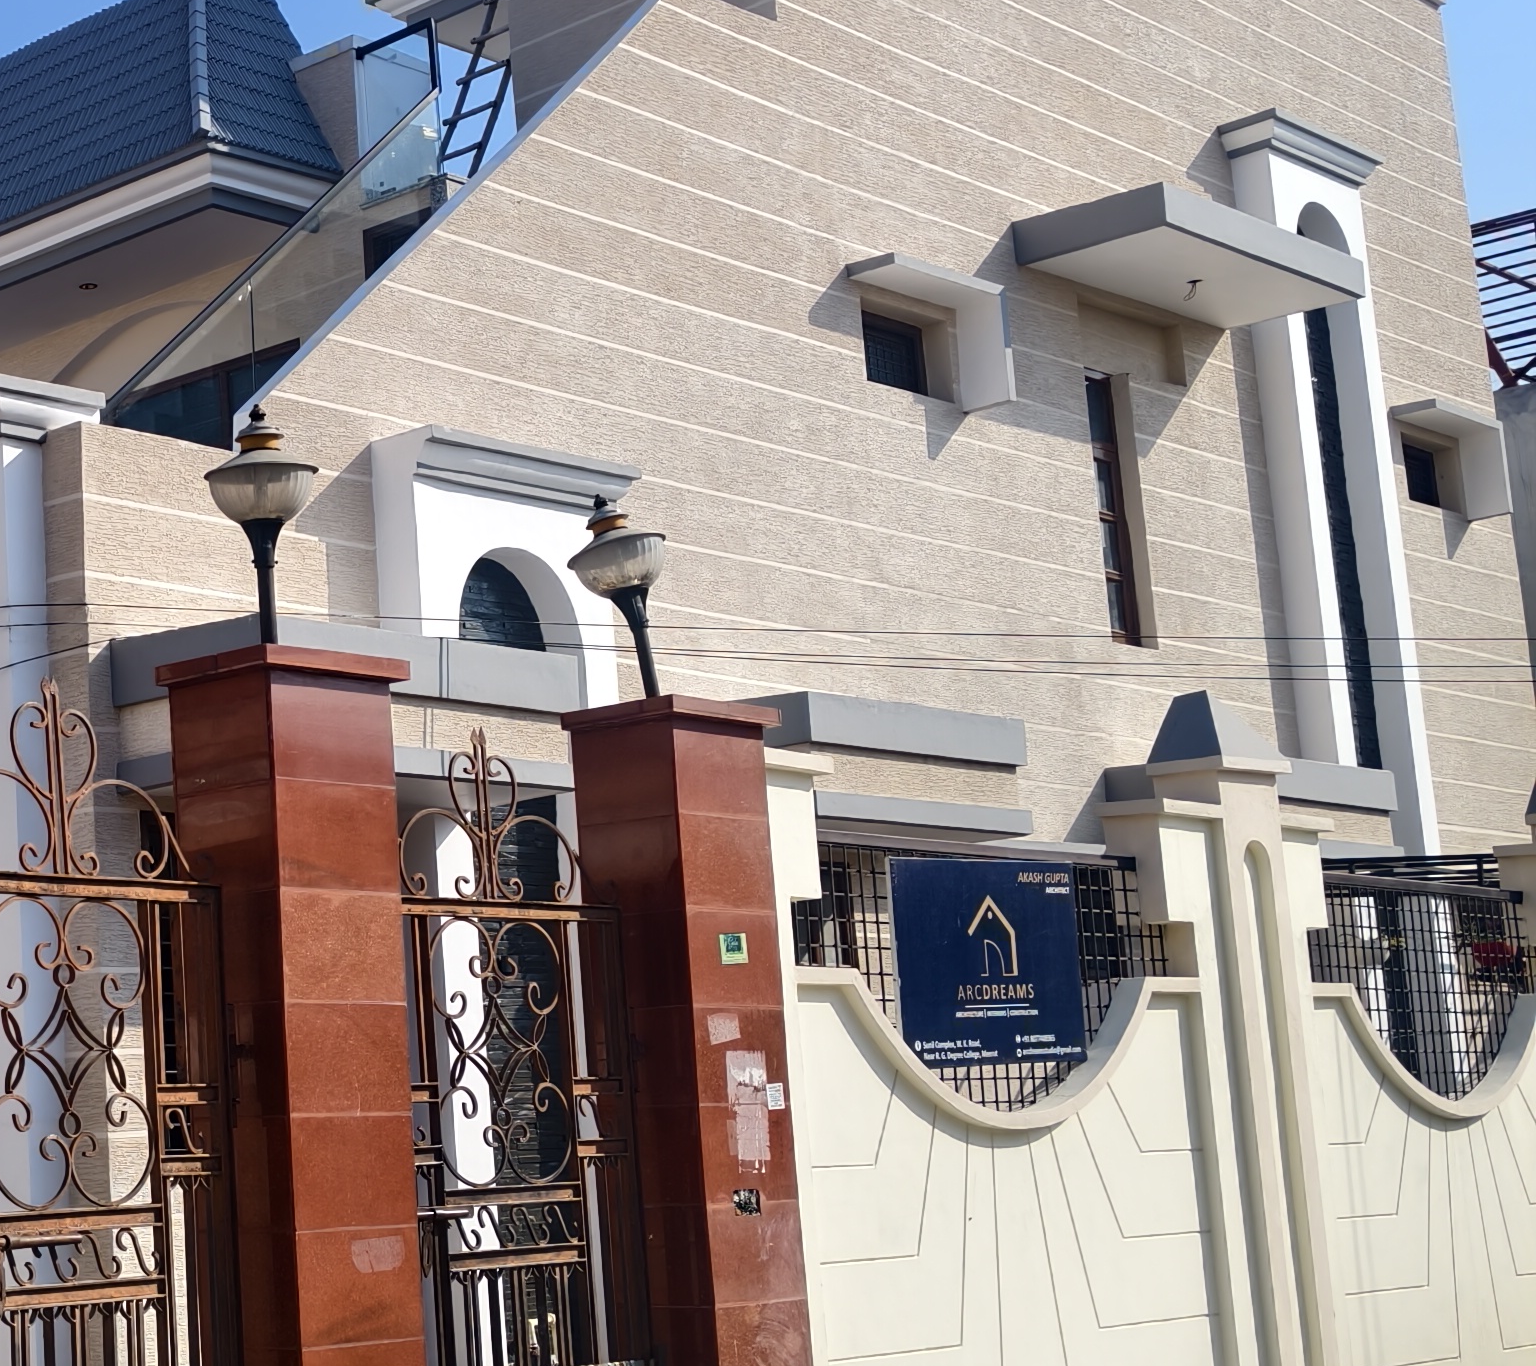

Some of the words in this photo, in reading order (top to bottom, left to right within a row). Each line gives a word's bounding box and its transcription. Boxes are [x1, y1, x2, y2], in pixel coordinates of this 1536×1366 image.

[1017, 872, 1043, 883] AKASH
[1044, 873, 1069, 883] GUPTA
[957, 983, 1035, 1000] ARCDREAMS
